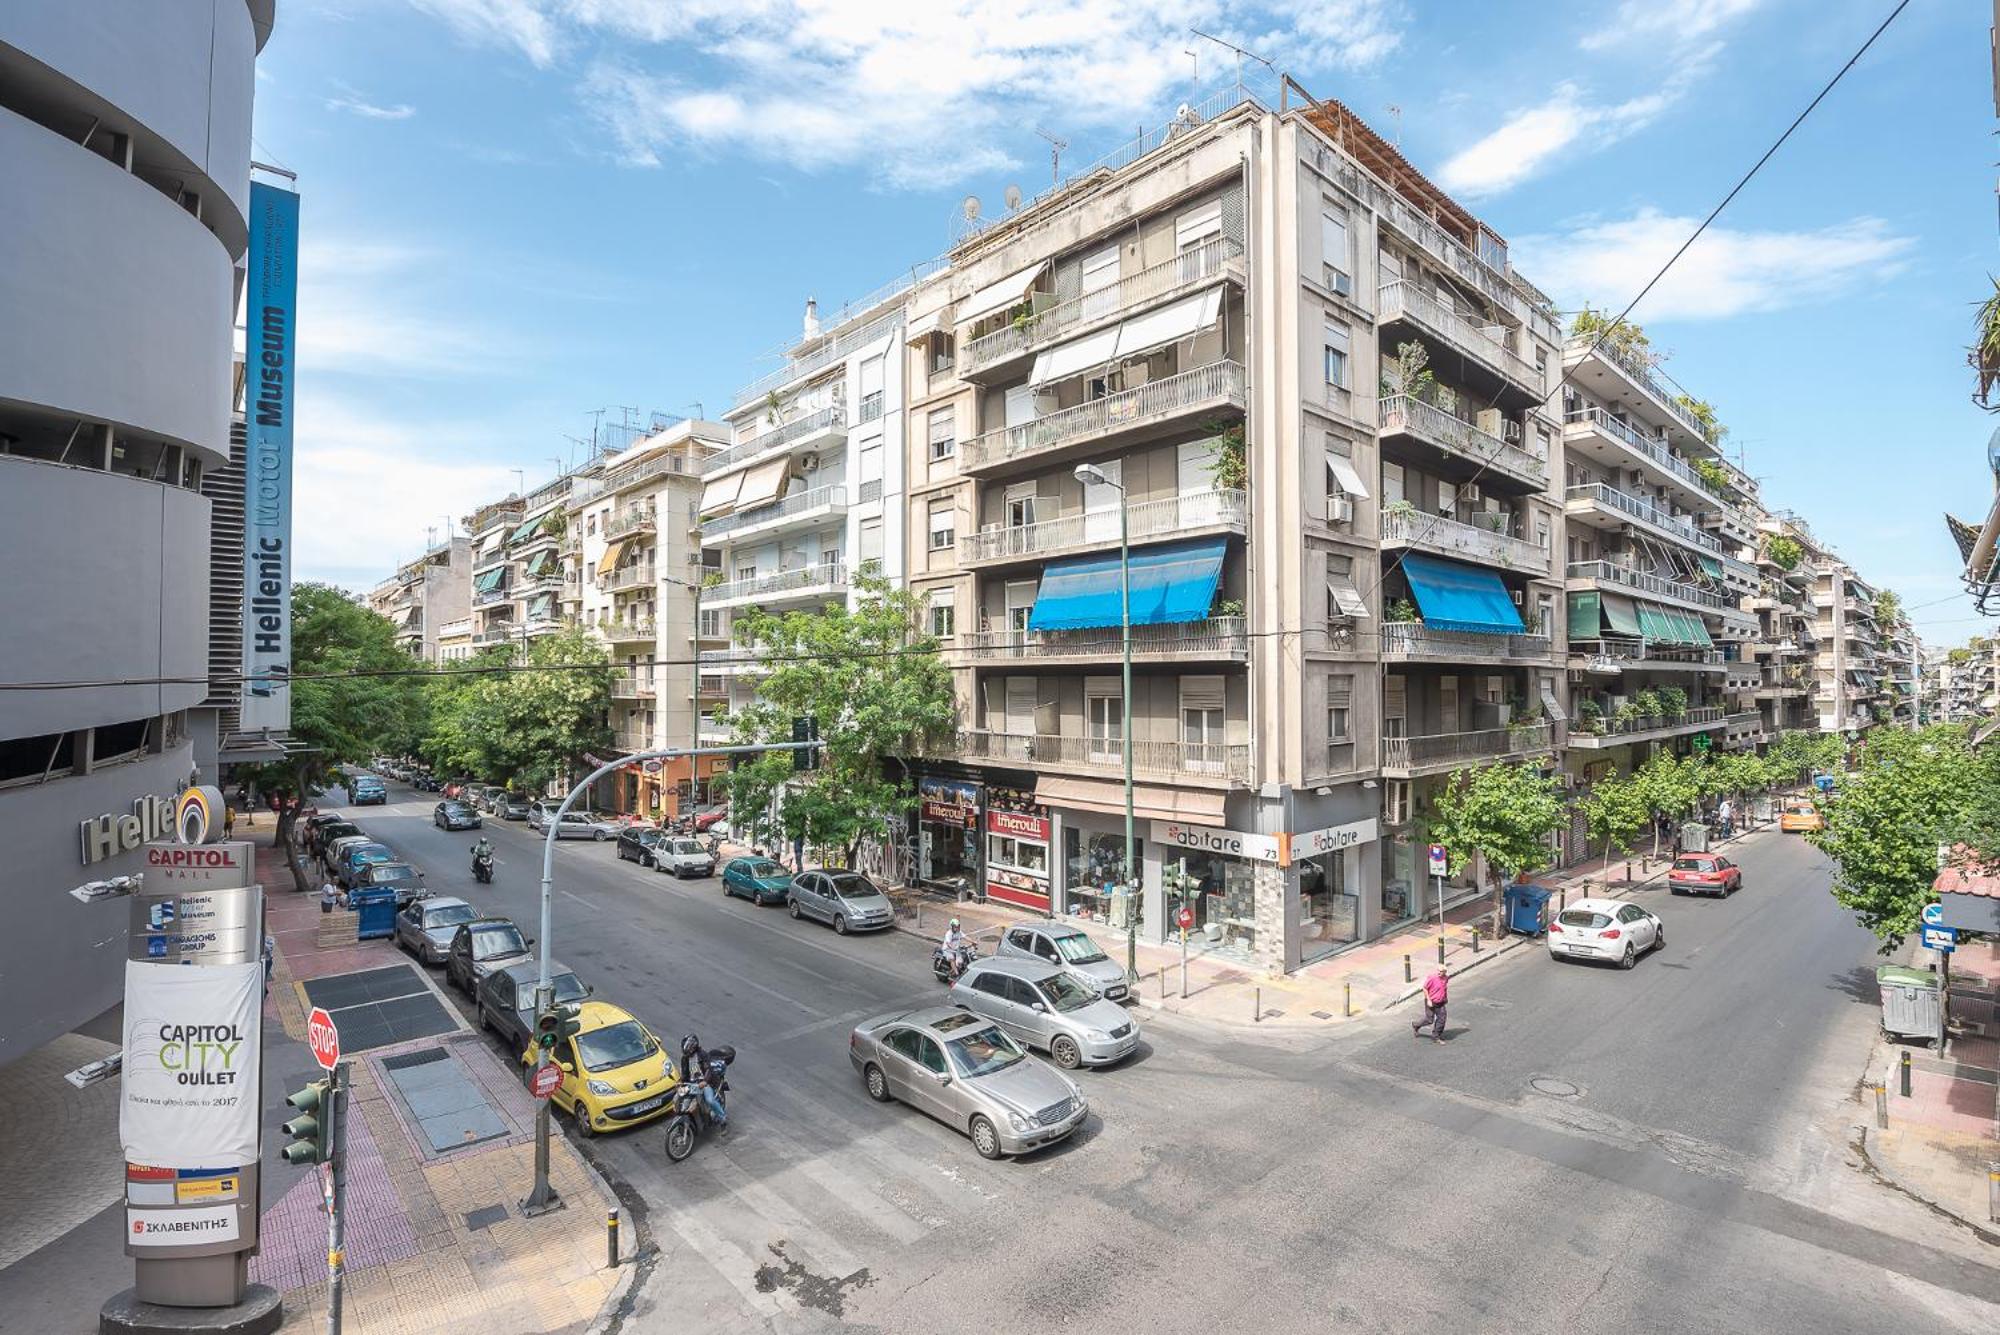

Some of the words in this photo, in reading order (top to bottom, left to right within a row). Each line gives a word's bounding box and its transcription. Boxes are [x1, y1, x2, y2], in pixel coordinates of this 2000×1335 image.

[256, 306, 286, 428] Museum
[252, 537, 283, 653] Hellenic
[81, 794, 178, 863] Helle
[1320, 830, 1358, 851] abitare
[1176, 827, 1241, 853] abitare
[1264, 849, 1277, 859] 73
[148, 849, 237, 866] CAPITOL
[164, 870, 213, 880] MALL
[160, 1024, 243, 1042] CAPITOL
[311, 1023, 337, 1055] STOP
[160, 1042, 240, 1070] CITY
[212, 1096, 238, 1107] 2017
[146, 1218, 229, 1234] ΣΚΛΑΒΕΝΙΤΗΣ
